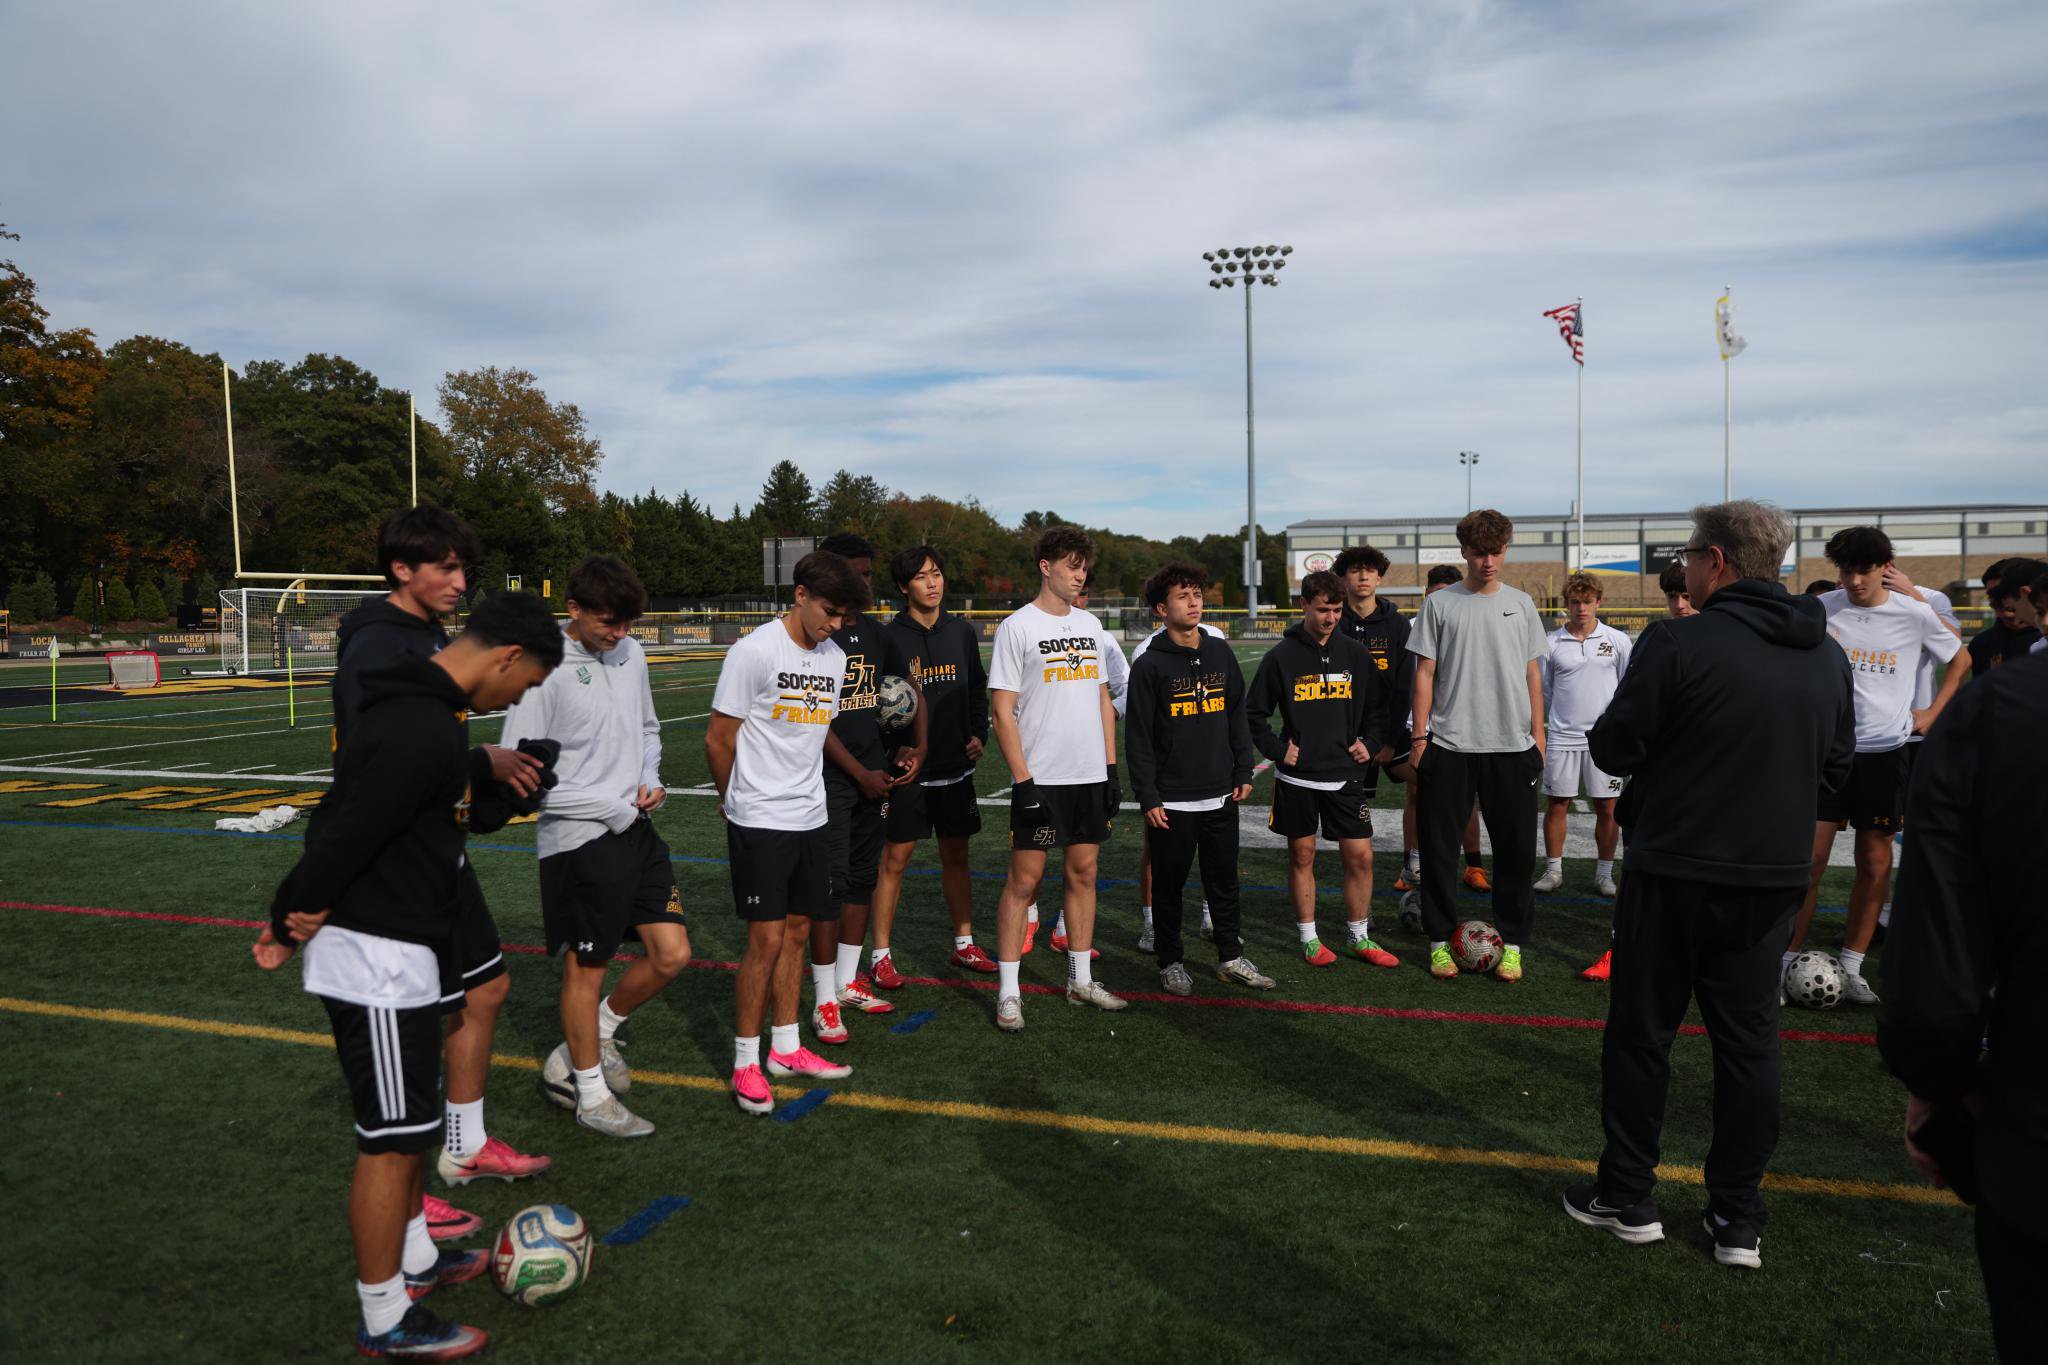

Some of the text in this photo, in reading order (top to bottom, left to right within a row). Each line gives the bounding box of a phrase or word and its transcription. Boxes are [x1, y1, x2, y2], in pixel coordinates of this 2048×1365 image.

[1038, 638, 1098, 655] SOCCER
[1598, 642, 1614, 653] SA
[922, 664, 956, 679] FRIARS
[1042, 665, 1100, 684] FRIARS
[1850, 662, 1896, 675] OCCER
[777, 672, 836, 693] SOCCER
[1294, 681, 1353, 702] SOCCER
[770, 704, 833, 725] FRIARS
[1033, 827, 1056, 845] SA
